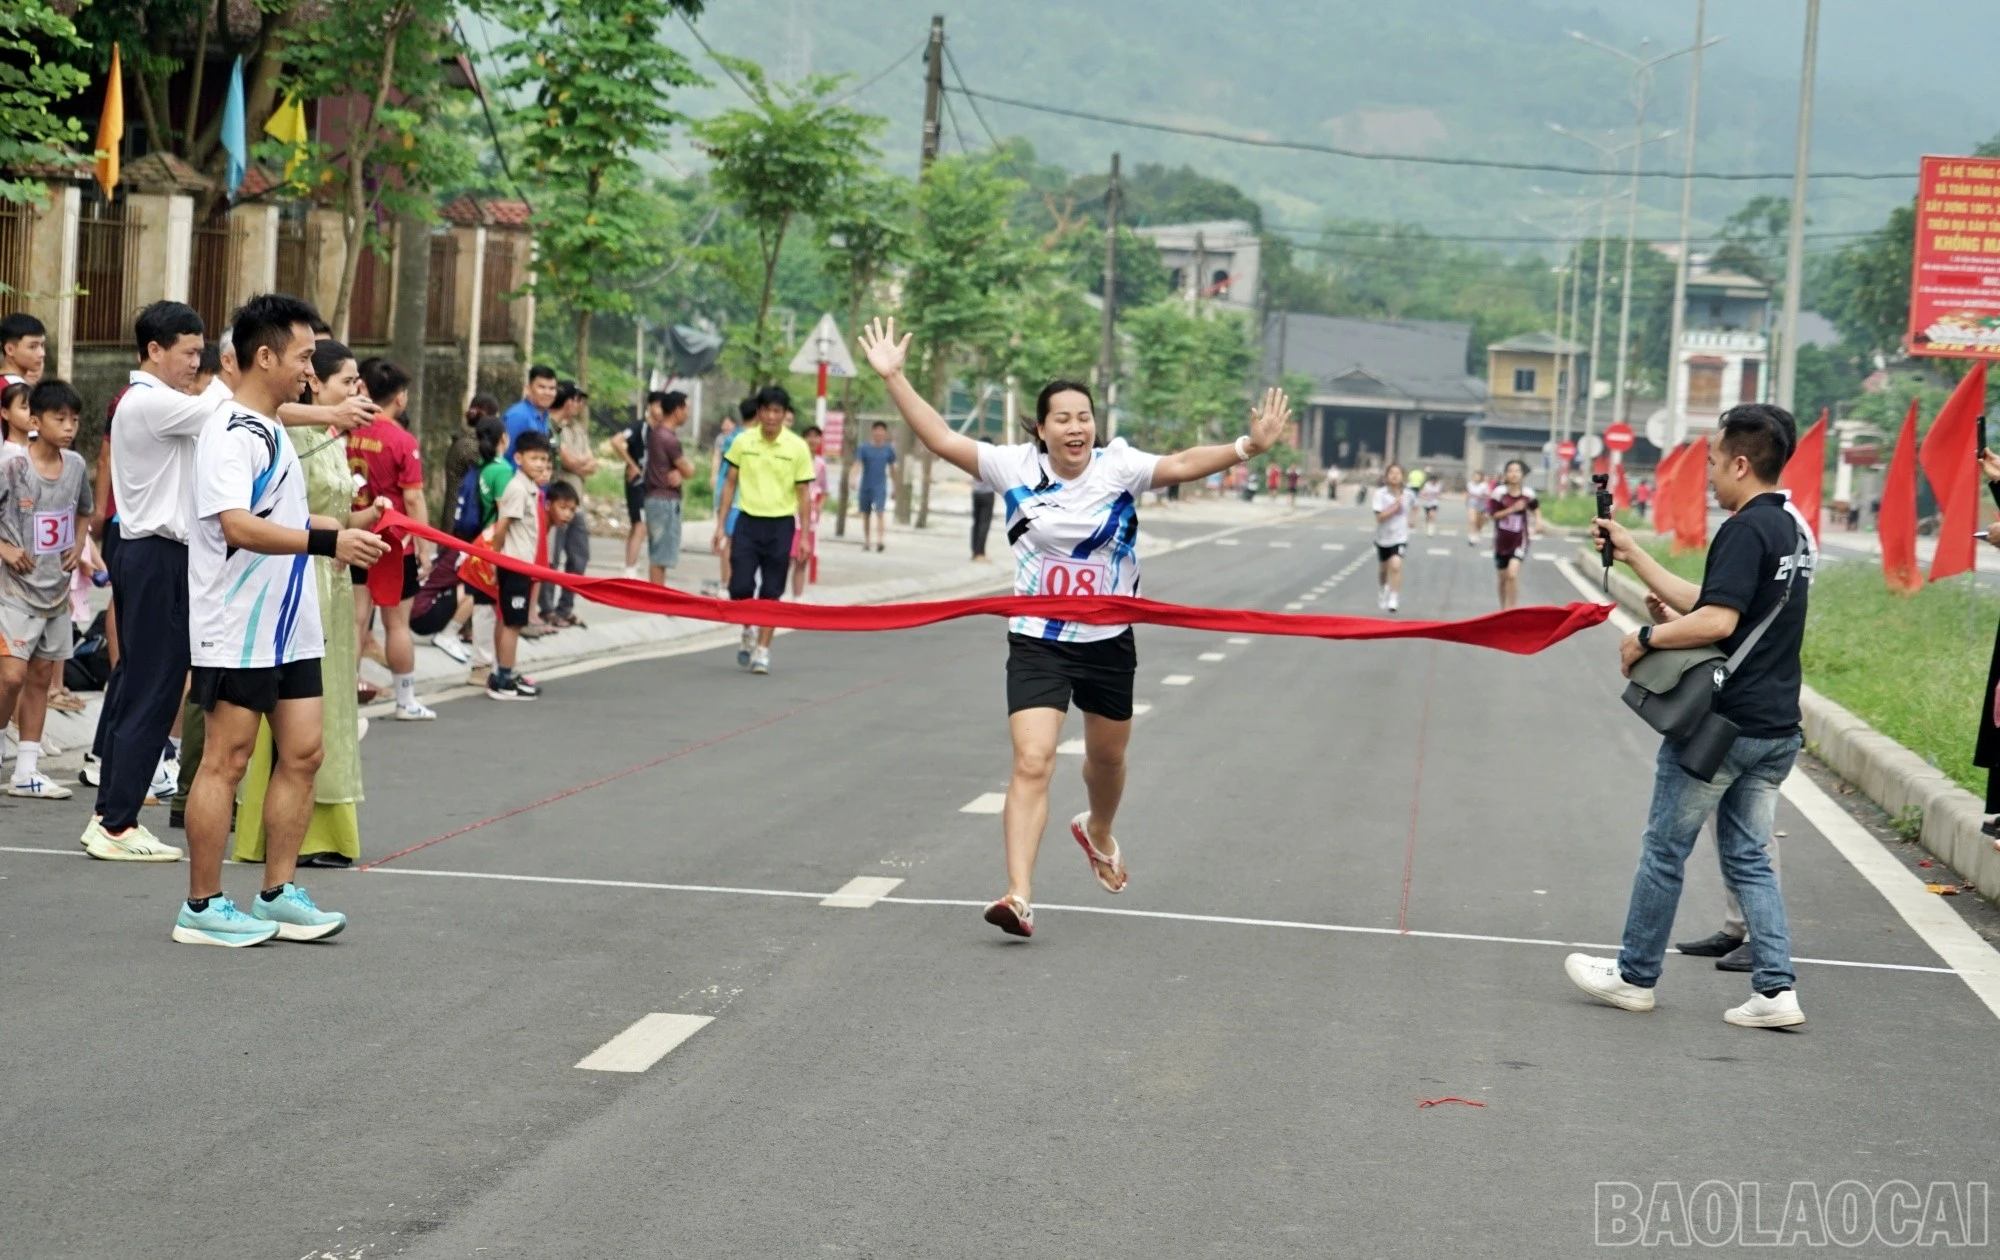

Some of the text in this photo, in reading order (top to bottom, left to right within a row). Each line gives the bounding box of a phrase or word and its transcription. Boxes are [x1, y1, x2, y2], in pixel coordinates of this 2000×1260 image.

[1934, 232, 1981, 252] KHÔNG
[41, 515, 69, 547] 37
[1046, 565, 1096, 597] 08
